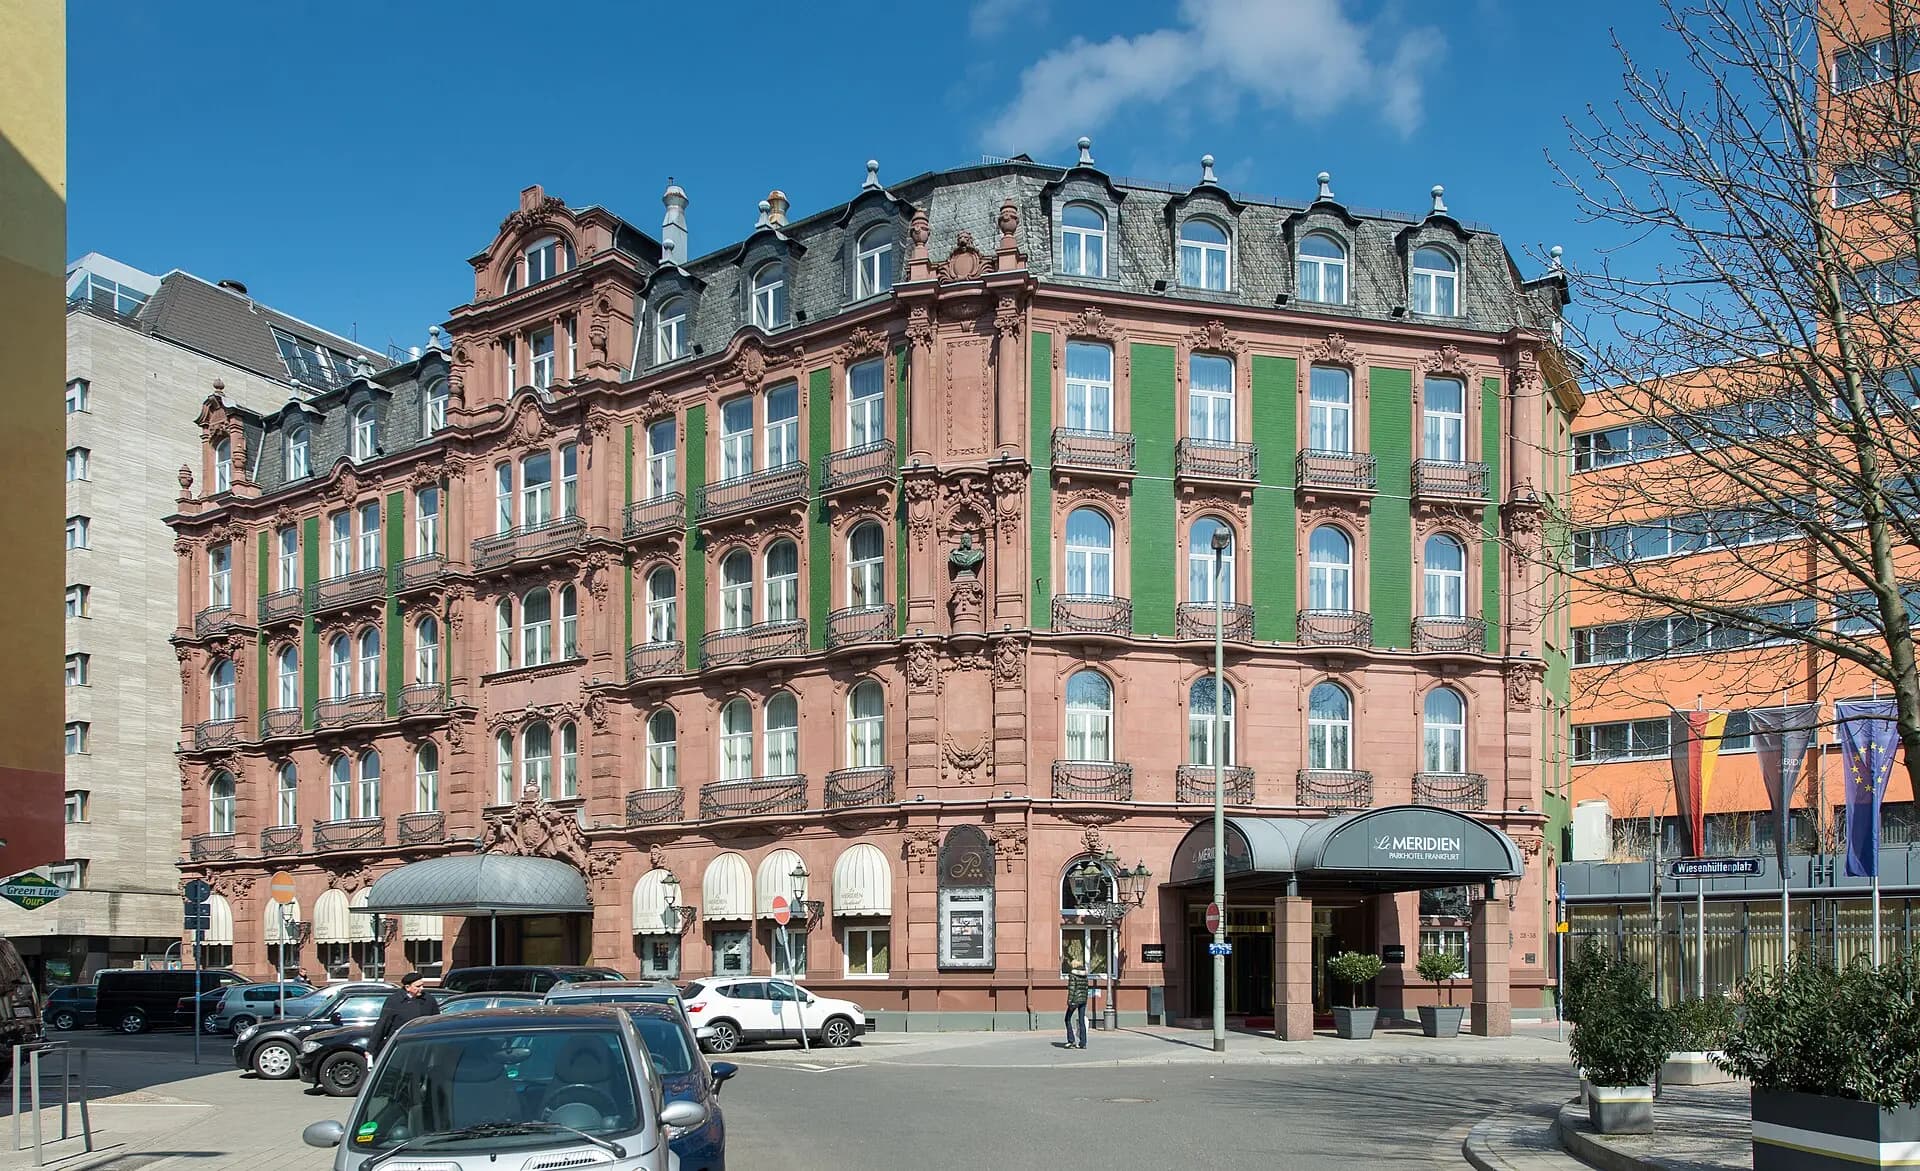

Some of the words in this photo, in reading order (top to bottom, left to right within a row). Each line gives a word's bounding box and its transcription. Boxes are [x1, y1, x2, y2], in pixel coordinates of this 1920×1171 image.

[1373, 835, 1391, 850] Le
[1392, 836, 1460, 851] MERIDIEN
[1389, 852, 1424, 860] PARKHOTEL
[1425, 852, 1460, 861] FRANKFURT
[1677, 861, 1753, 873] Wiesenhüttenplatz
[7, 886, 36, 895] Green
[38, 887, 60, 897] Line
[22, 896, 45, 906] Tours
